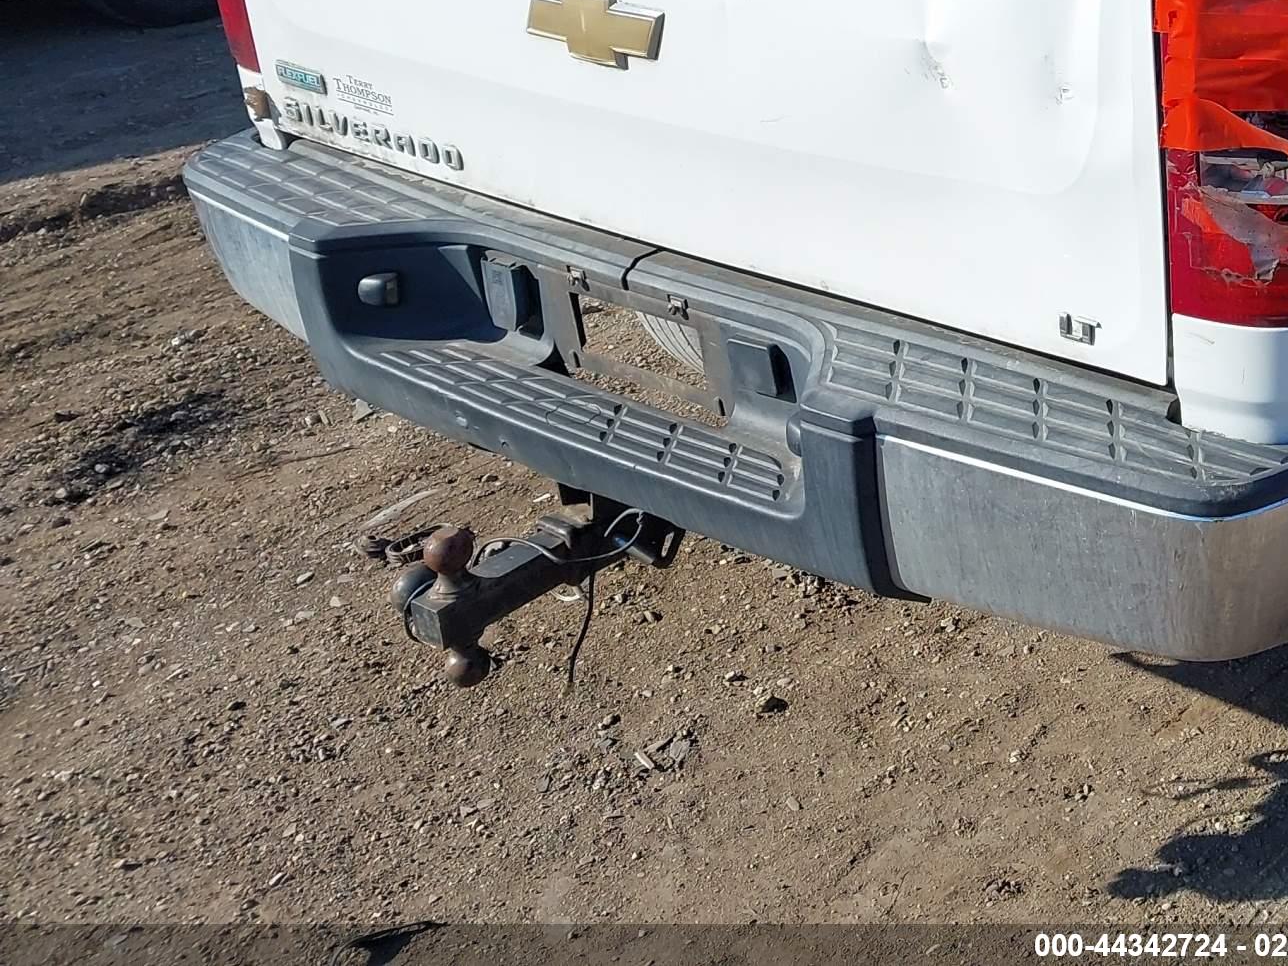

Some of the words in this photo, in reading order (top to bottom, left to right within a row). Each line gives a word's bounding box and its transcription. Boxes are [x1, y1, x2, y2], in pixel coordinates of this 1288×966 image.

[277, 65, 321, 87] FLEXFUEL
[345, 74, 373, 90] TERRY
[332, 77, 392, 105] THOMPSON
[283, 96, 464, 171] SILVERADO
[1058, 310, 1102, 346] LT
